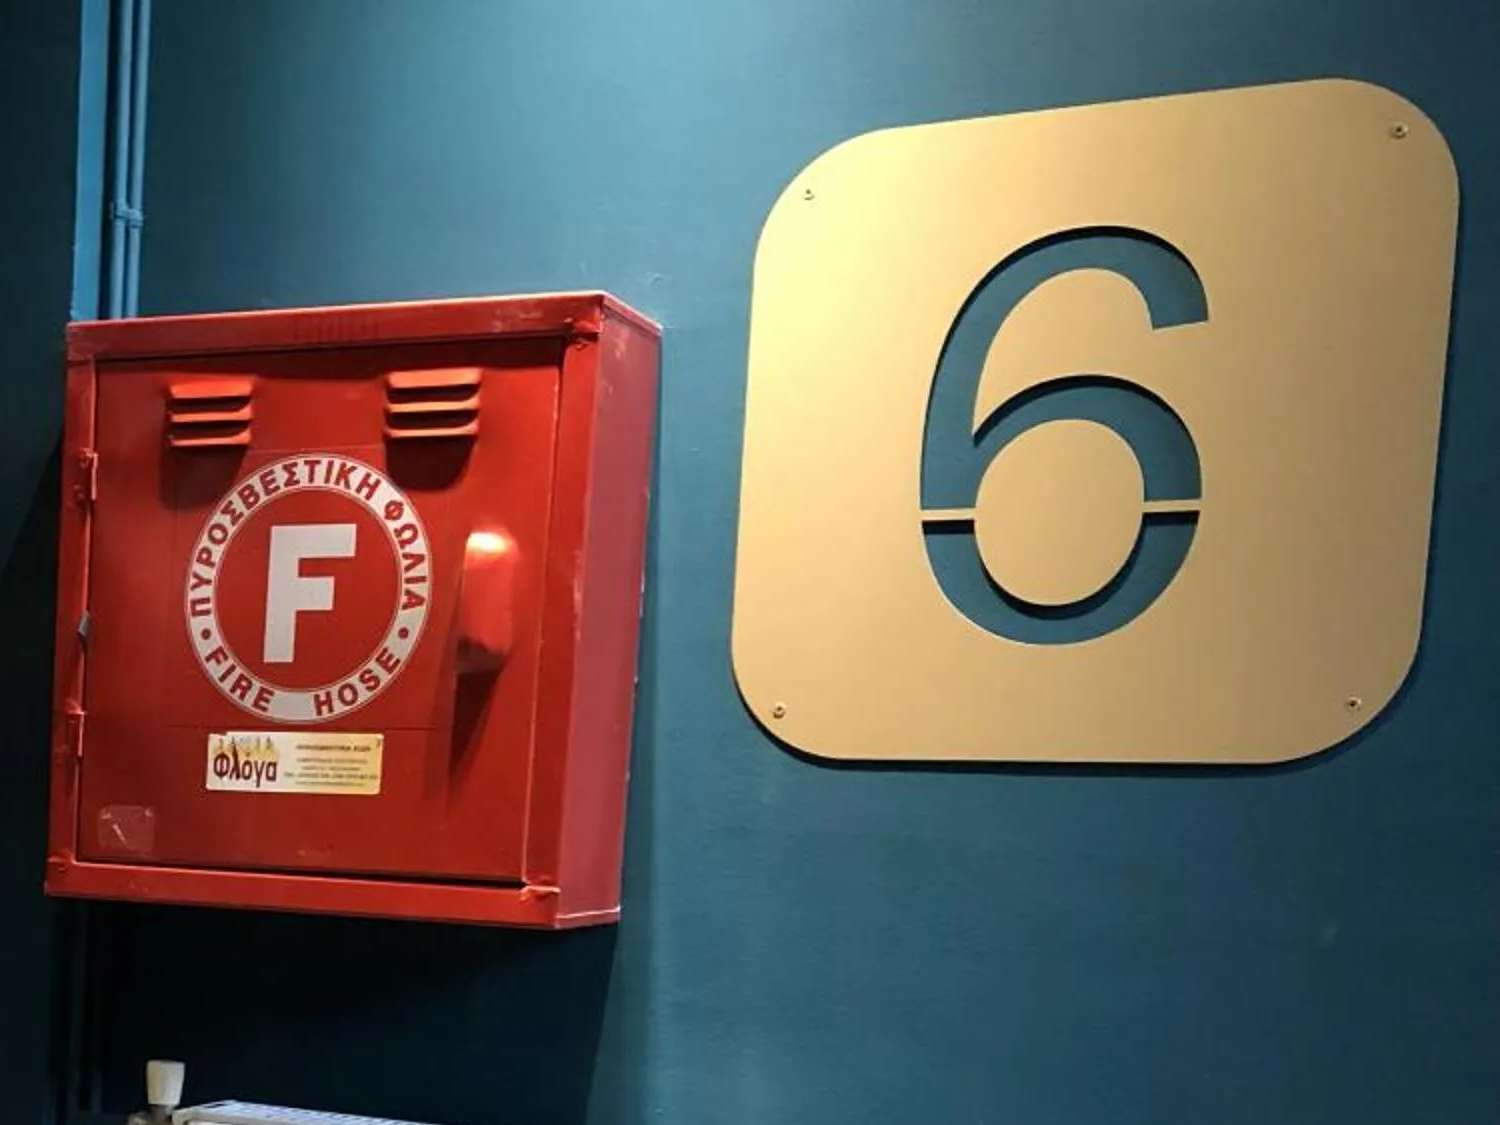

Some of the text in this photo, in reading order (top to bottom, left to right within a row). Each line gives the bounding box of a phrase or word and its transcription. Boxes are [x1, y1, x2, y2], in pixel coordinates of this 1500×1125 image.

[919, 224, 1210, 646] 6
[190, 459, 428, 618] ΠΥΡΟΣΒΕΣΤΙΚΗ ΦΩΛΙΑ
[263, 523, 357, 663] F
[204, 646, 401, 717] FIRE HOSE
[213, 741, 278, 788] Φλόγα
